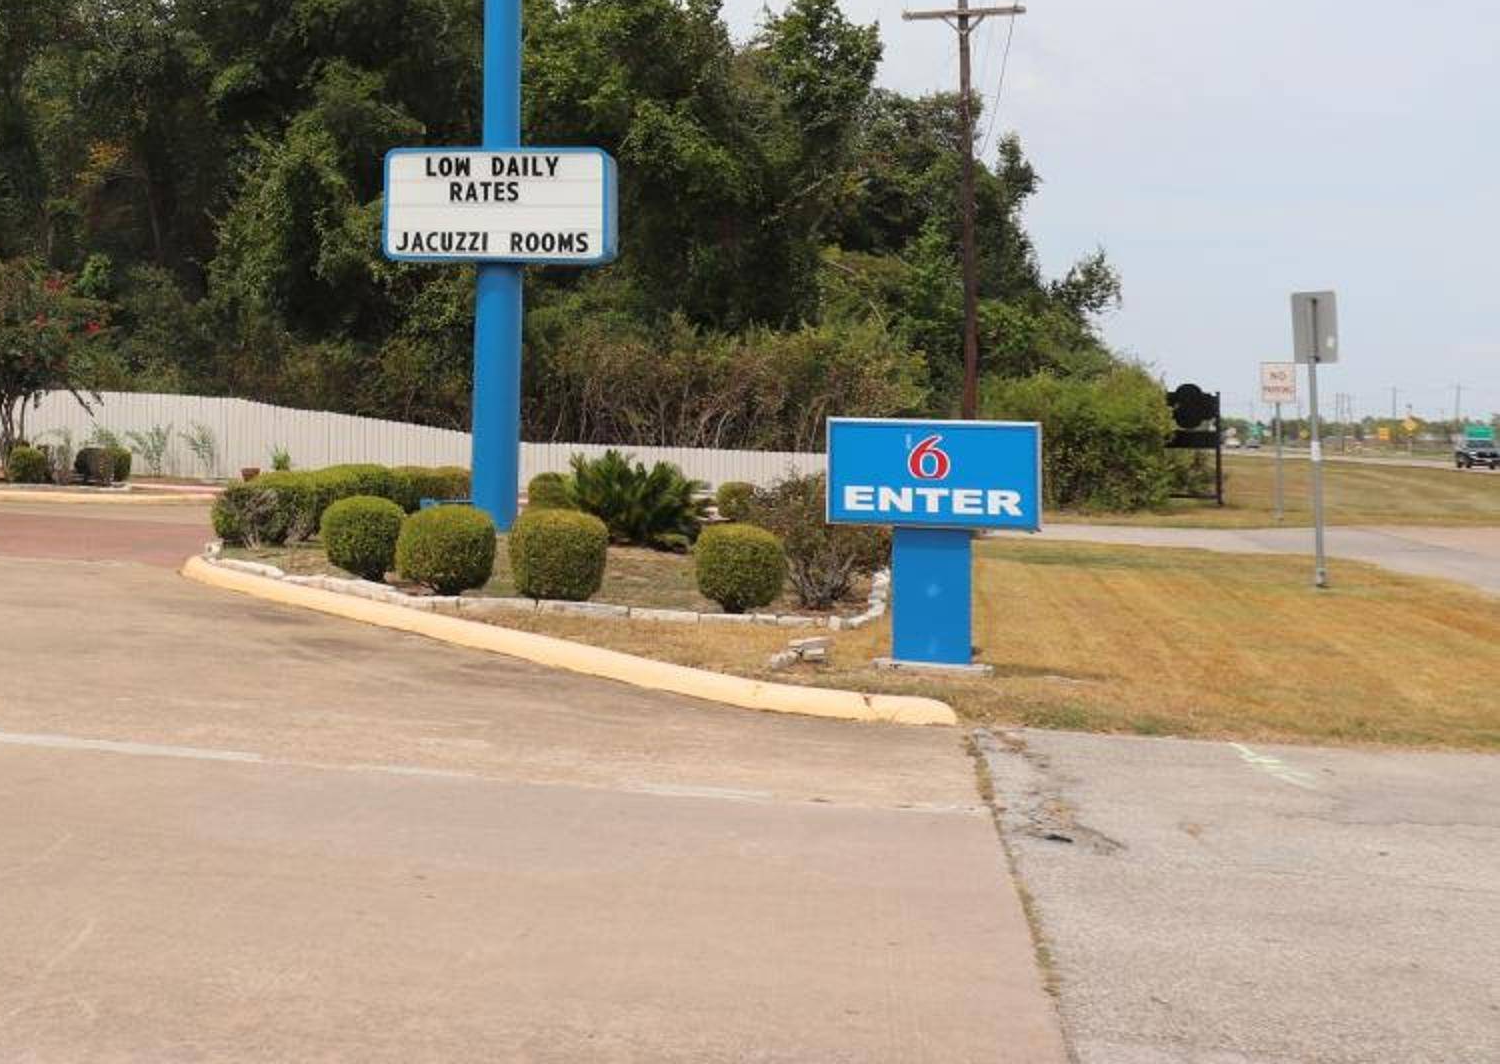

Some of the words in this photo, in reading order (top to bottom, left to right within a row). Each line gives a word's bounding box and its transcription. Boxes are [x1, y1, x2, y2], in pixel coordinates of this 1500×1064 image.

[425, 156, 471, 177] LOW
[491, 156, 560, 177] DAILY
[449, 181, 520, 202] RATES
[395, 231, 489, 252] JACUZZI
[510, 232, 589, 253] ROOMS
[907, 435, 951, 480] 6
[843, 485, 1024, 517] ENTER
